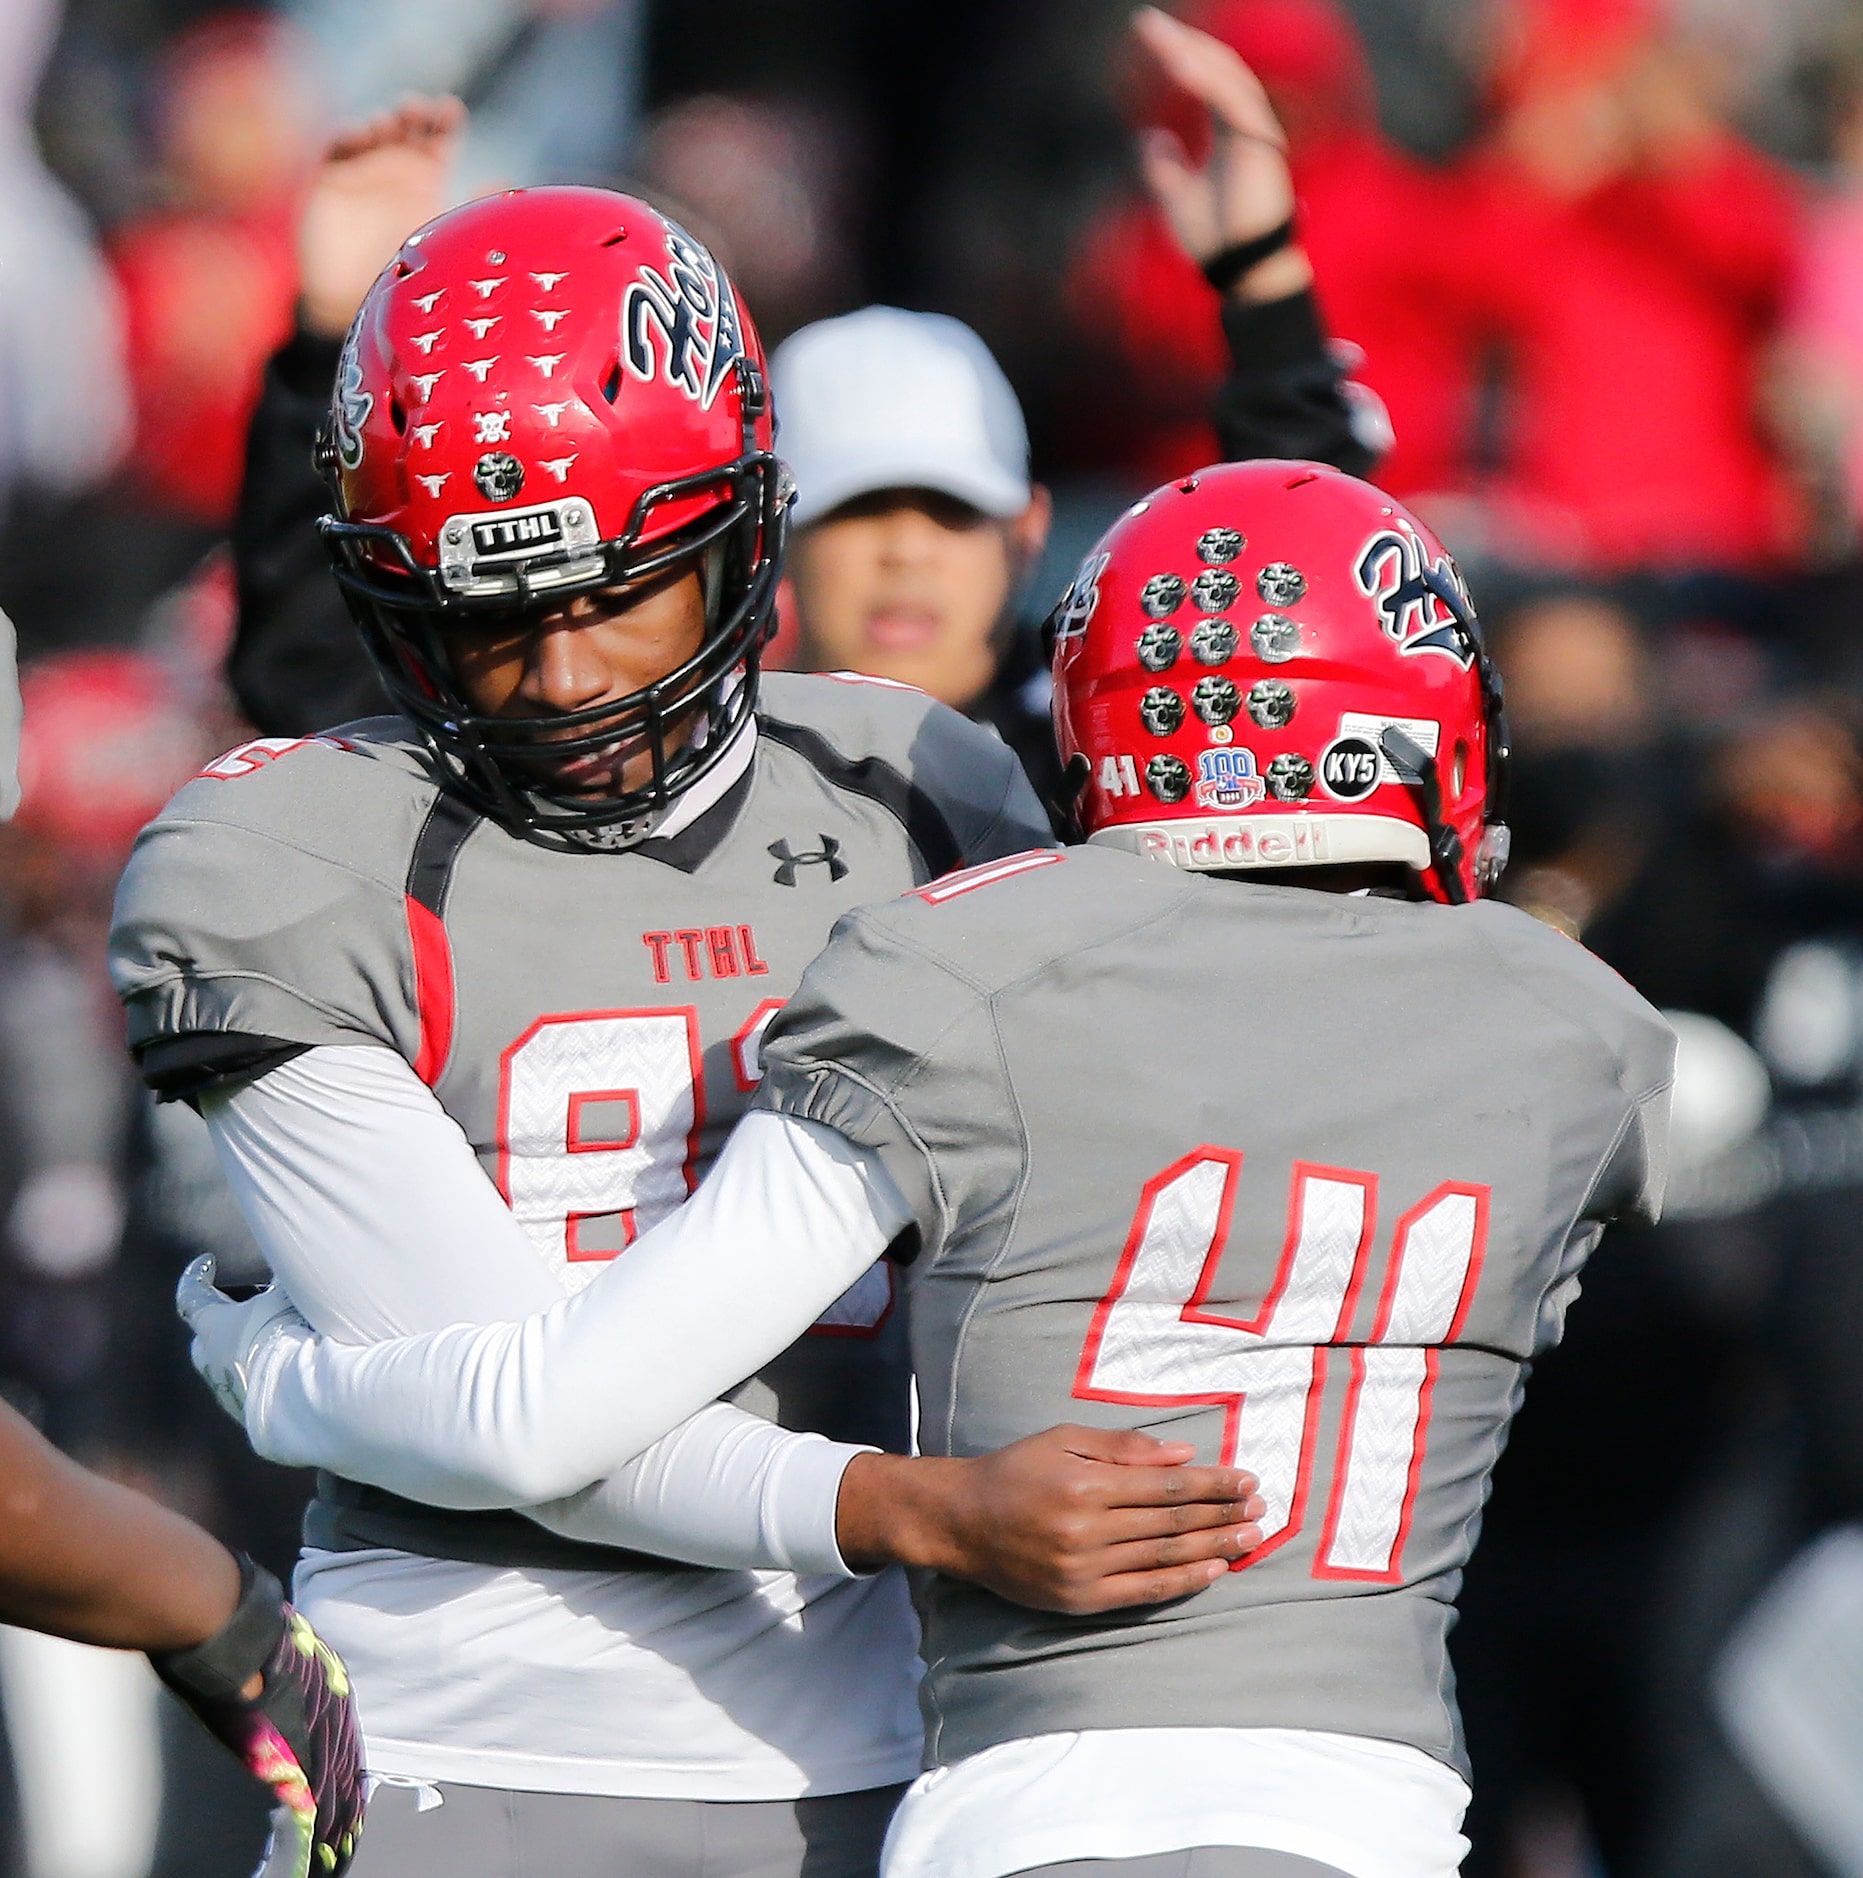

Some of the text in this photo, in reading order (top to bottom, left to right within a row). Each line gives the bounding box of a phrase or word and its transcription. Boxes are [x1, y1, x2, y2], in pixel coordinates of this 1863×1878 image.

[476, 514, 560, 547] TTHL
[1101, 754, 1141, 798] 41
[1203, 752, 1251, 781] 100
[1325, 752, 1376, 784] KY5
[1135, 820, 1330, 868] Riddell
[643, 924, 769, 983] TTHL
[1071, 1143, 1492, 1585] 41
